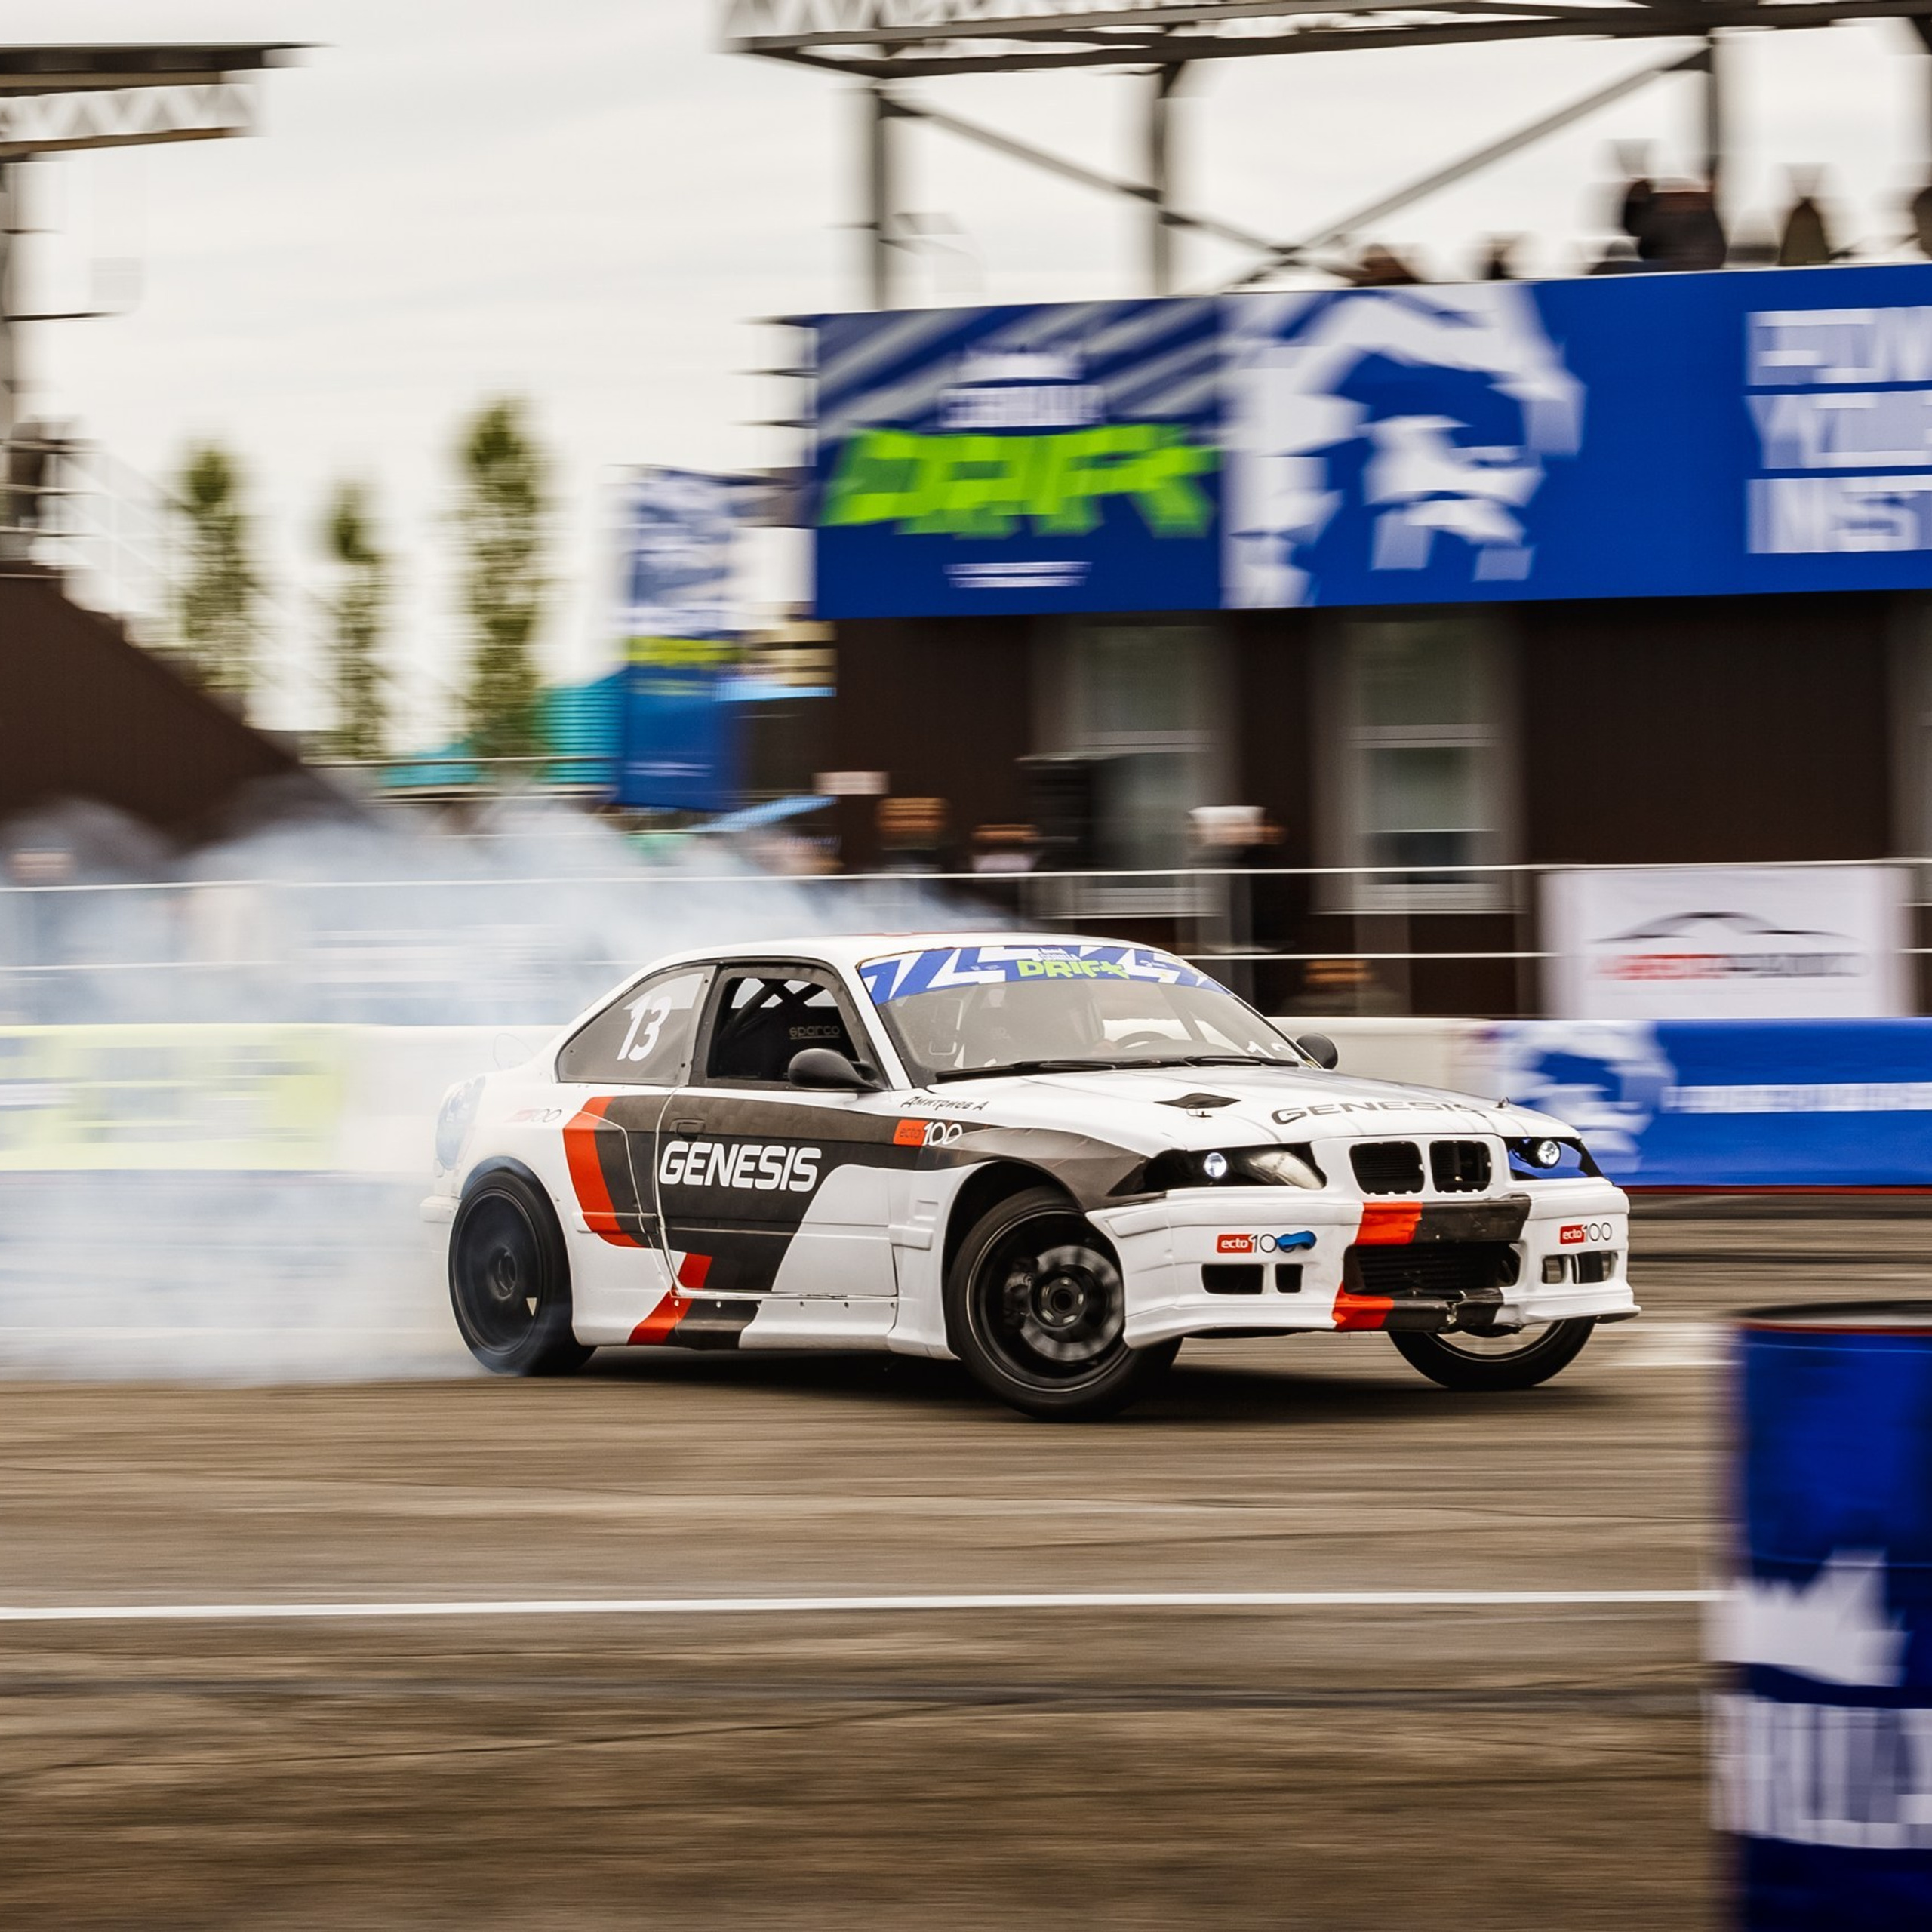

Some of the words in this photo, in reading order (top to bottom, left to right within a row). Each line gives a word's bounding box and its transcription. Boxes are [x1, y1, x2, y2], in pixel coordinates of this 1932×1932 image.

[1017, 960, 1130, 980] DRIFT
[616, 995, 672, 1061] 13
[789, 1026, 841, 1039] sparco
[1271, 1101, 1480, 1125] GENESIS
[659, 1140, 822, 1192] GENESIS
